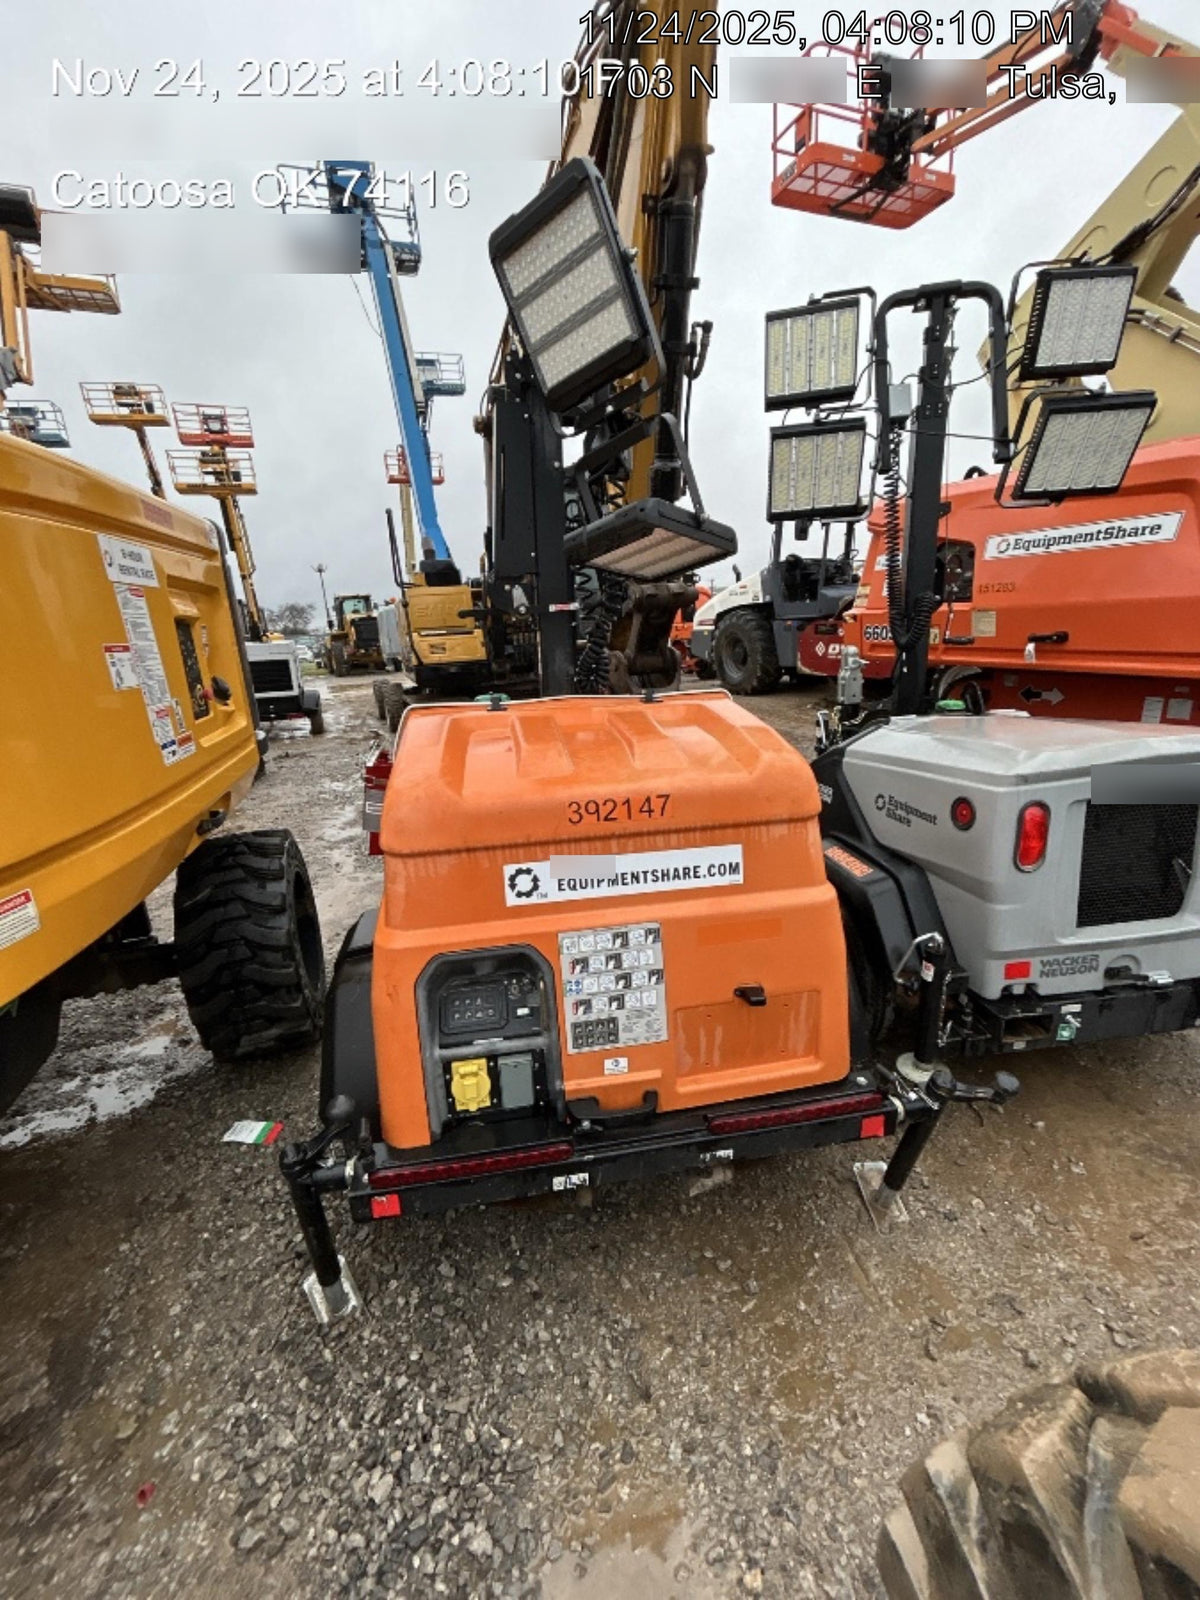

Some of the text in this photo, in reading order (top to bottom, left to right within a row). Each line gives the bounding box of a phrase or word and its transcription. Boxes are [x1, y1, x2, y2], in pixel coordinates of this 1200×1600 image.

[1012, 523, 1162, 552] EquipmentShare
[567, 793, 671, 825] 392147
[885, 807, 912, 827] Share
[887, 794, 938, 825] Equipment
[1039, 954, 1100, 970] WACKER
[1039, 965, 1100, 978] NEUSON
